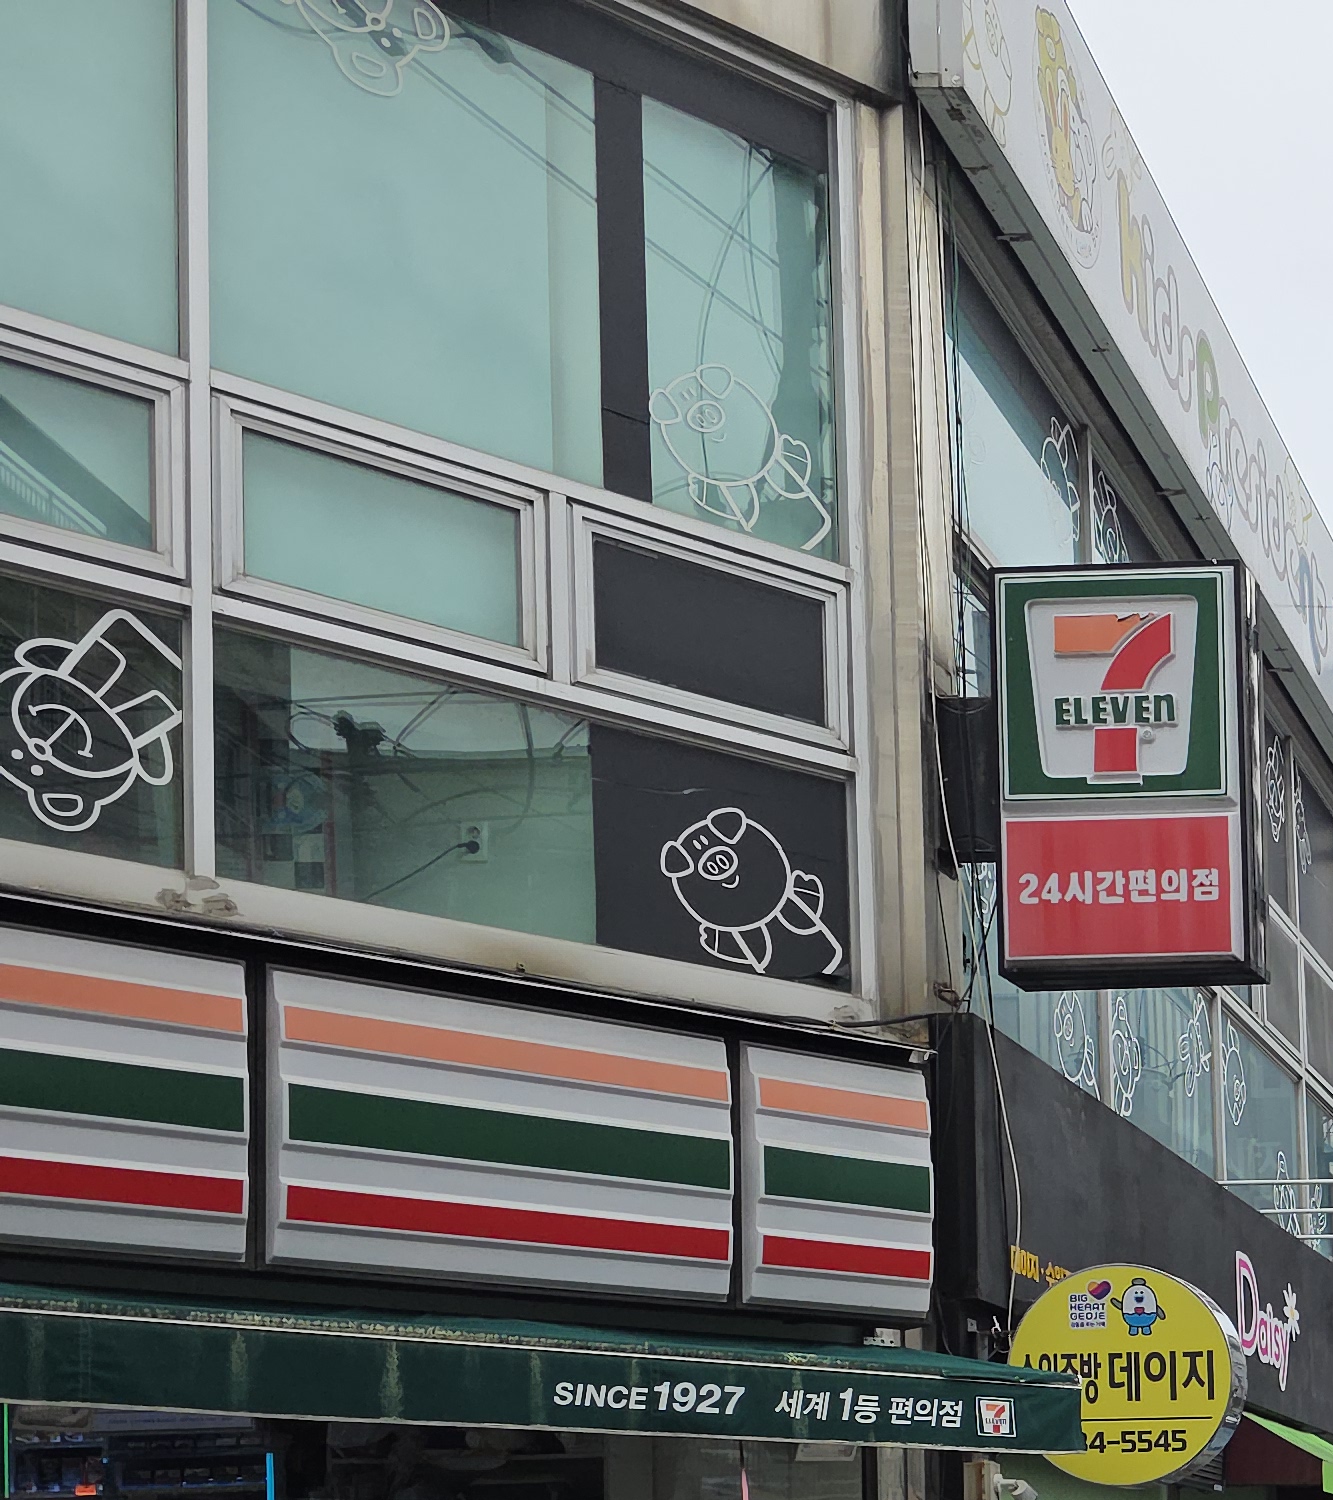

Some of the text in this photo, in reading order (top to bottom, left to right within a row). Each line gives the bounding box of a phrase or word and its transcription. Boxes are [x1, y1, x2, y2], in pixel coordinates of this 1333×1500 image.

[1018, 868, 1220, 905] 24시간편의점
[1069, 1293, 1088, 1303] BIG
[1069, 1302, 1106, 1312] HEART
[1069, 1311, 1106, 1321] GEOJE
[1236, 1251, 1290, 1392] Daisy
[1108, 1349, 1215, 1402] 데이지
[553, 1380, 746, 1416] SINCE 1927
[774, 1386, 964, 1428] 세계 1등 편의점
